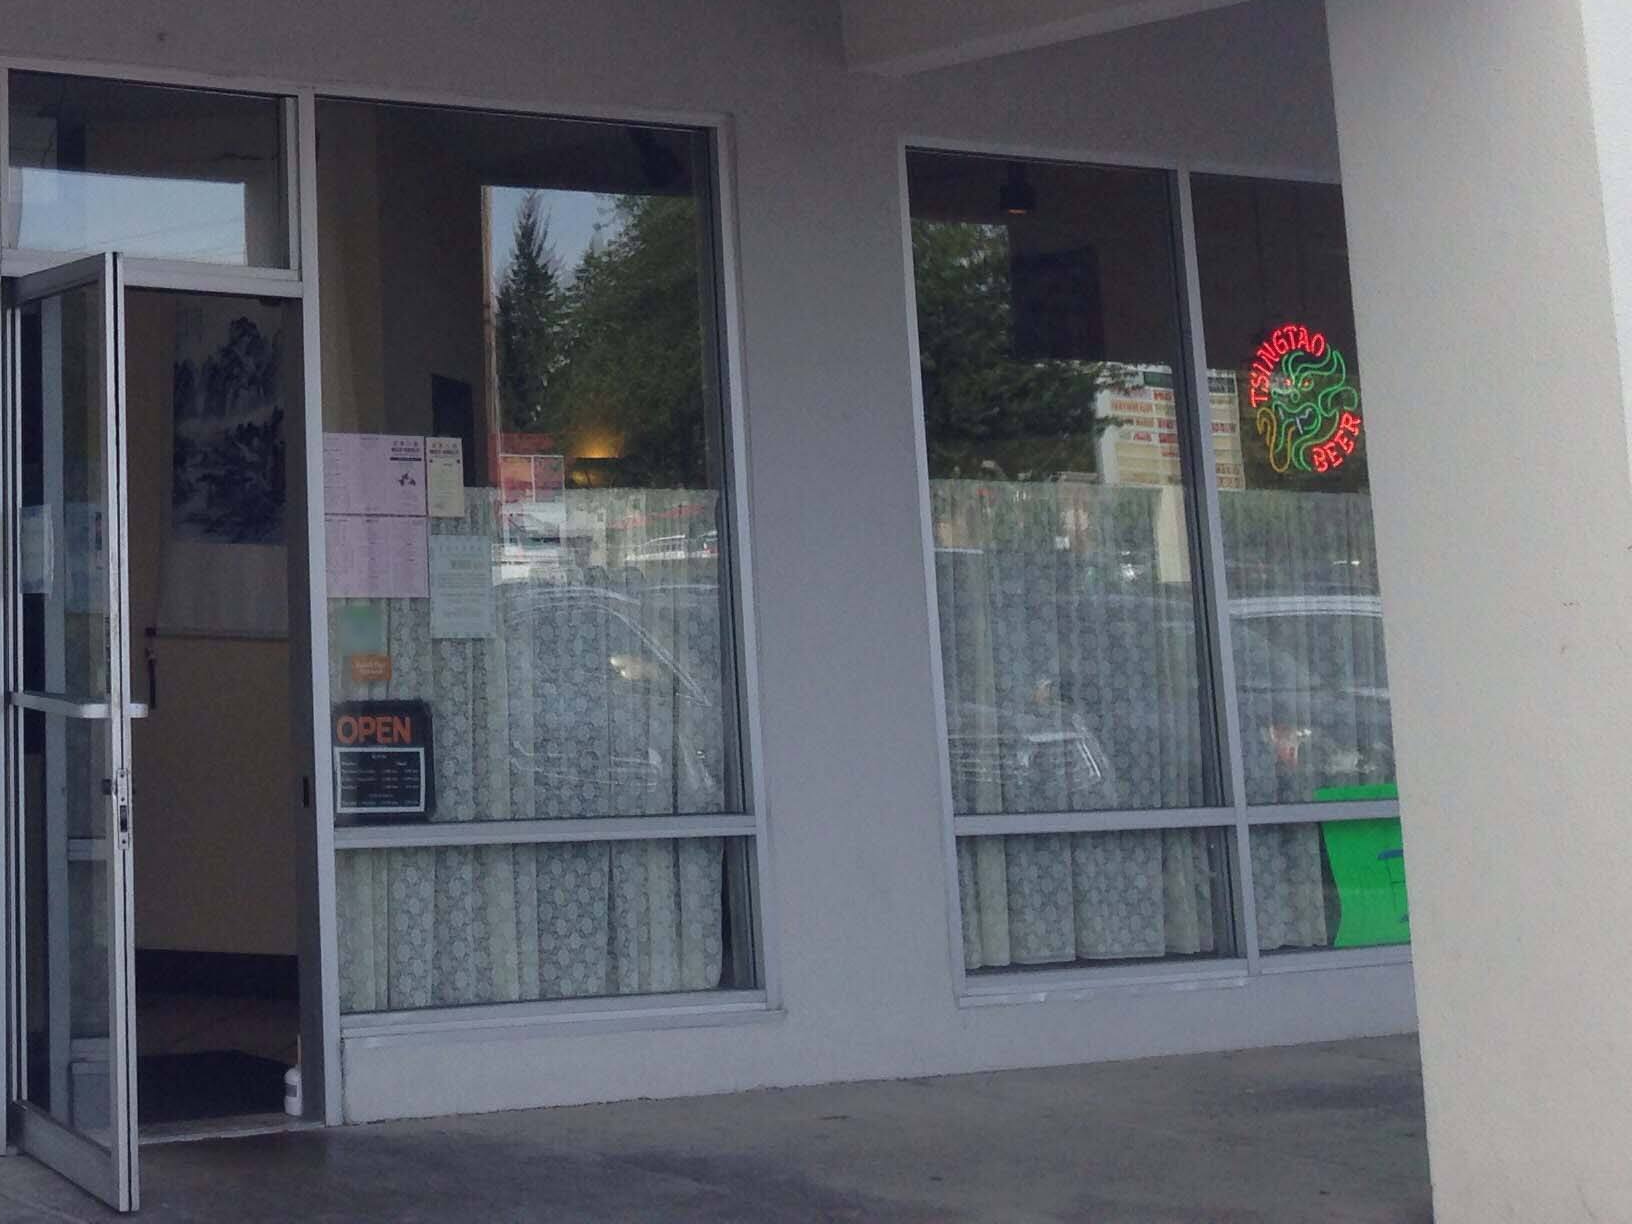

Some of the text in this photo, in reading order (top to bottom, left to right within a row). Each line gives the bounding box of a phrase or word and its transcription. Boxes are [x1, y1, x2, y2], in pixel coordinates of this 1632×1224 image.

[1250, 325, 1362, 473] TSINGTAO BEER
[335, 714, 412, 745] OPEN
